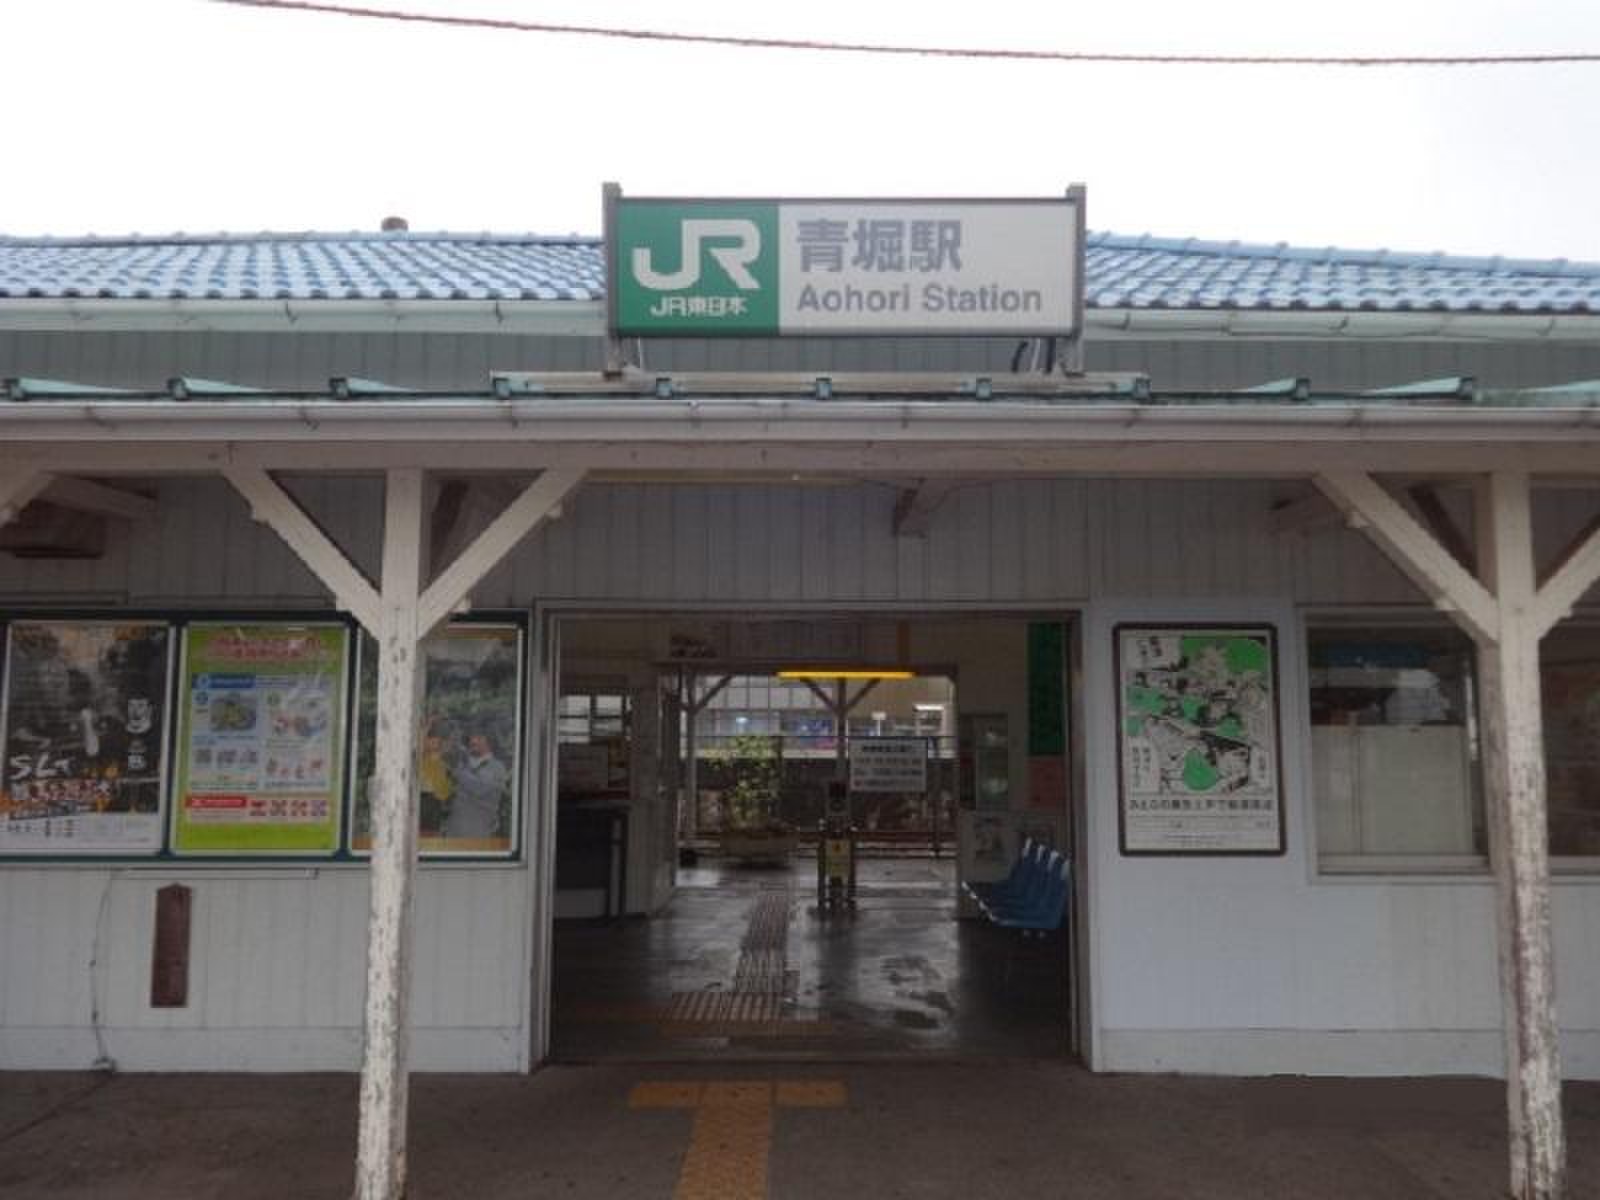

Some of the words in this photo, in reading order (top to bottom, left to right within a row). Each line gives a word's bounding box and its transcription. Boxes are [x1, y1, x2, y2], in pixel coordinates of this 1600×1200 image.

[631, 218, 762, 291] JR
[796, 218, 963, 274] 青堀駅
[649, 295, 749, 319] JR東日本
[797, 282, 911, 313] Aohori
[921, 282, 1042, 313] Station
